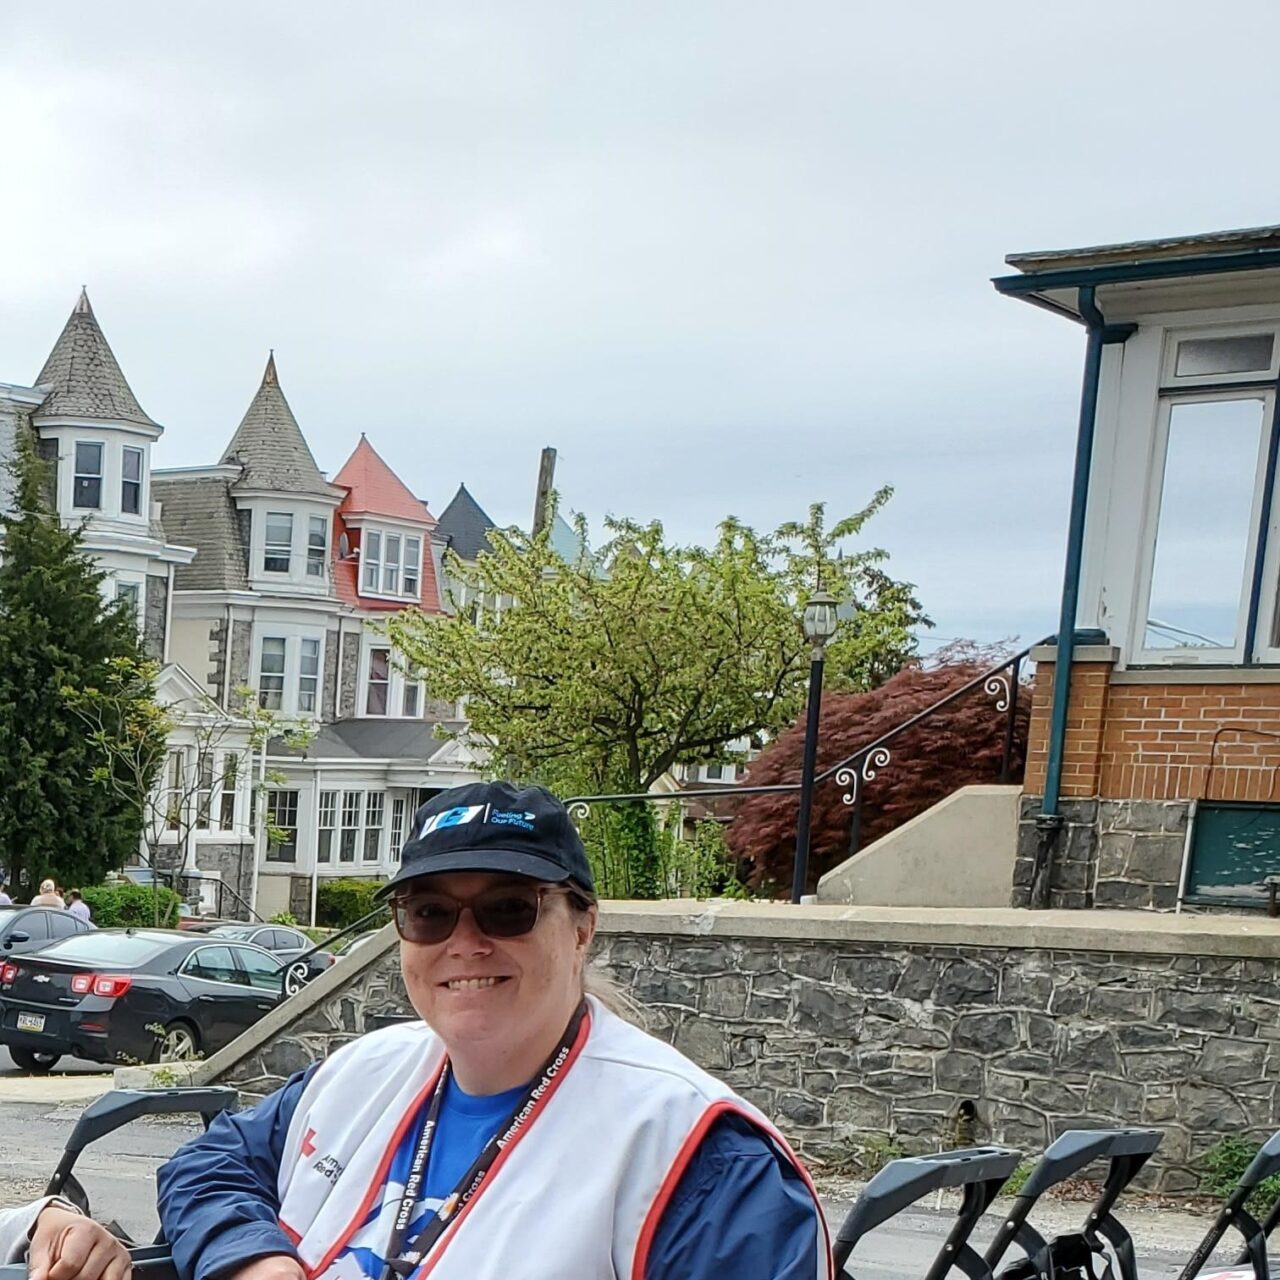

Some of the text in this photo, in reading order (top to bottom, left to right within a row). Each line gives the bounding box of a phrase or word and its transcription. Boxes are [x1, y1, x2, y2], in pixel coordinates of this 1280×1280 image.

[496, 1046, 571, 1151] American Red Cross
[313, 1161, 334, 1179] Red
[396, 1120, 436, 1230] American Red Cross
[463, 1170, 486, 1202] Cross
